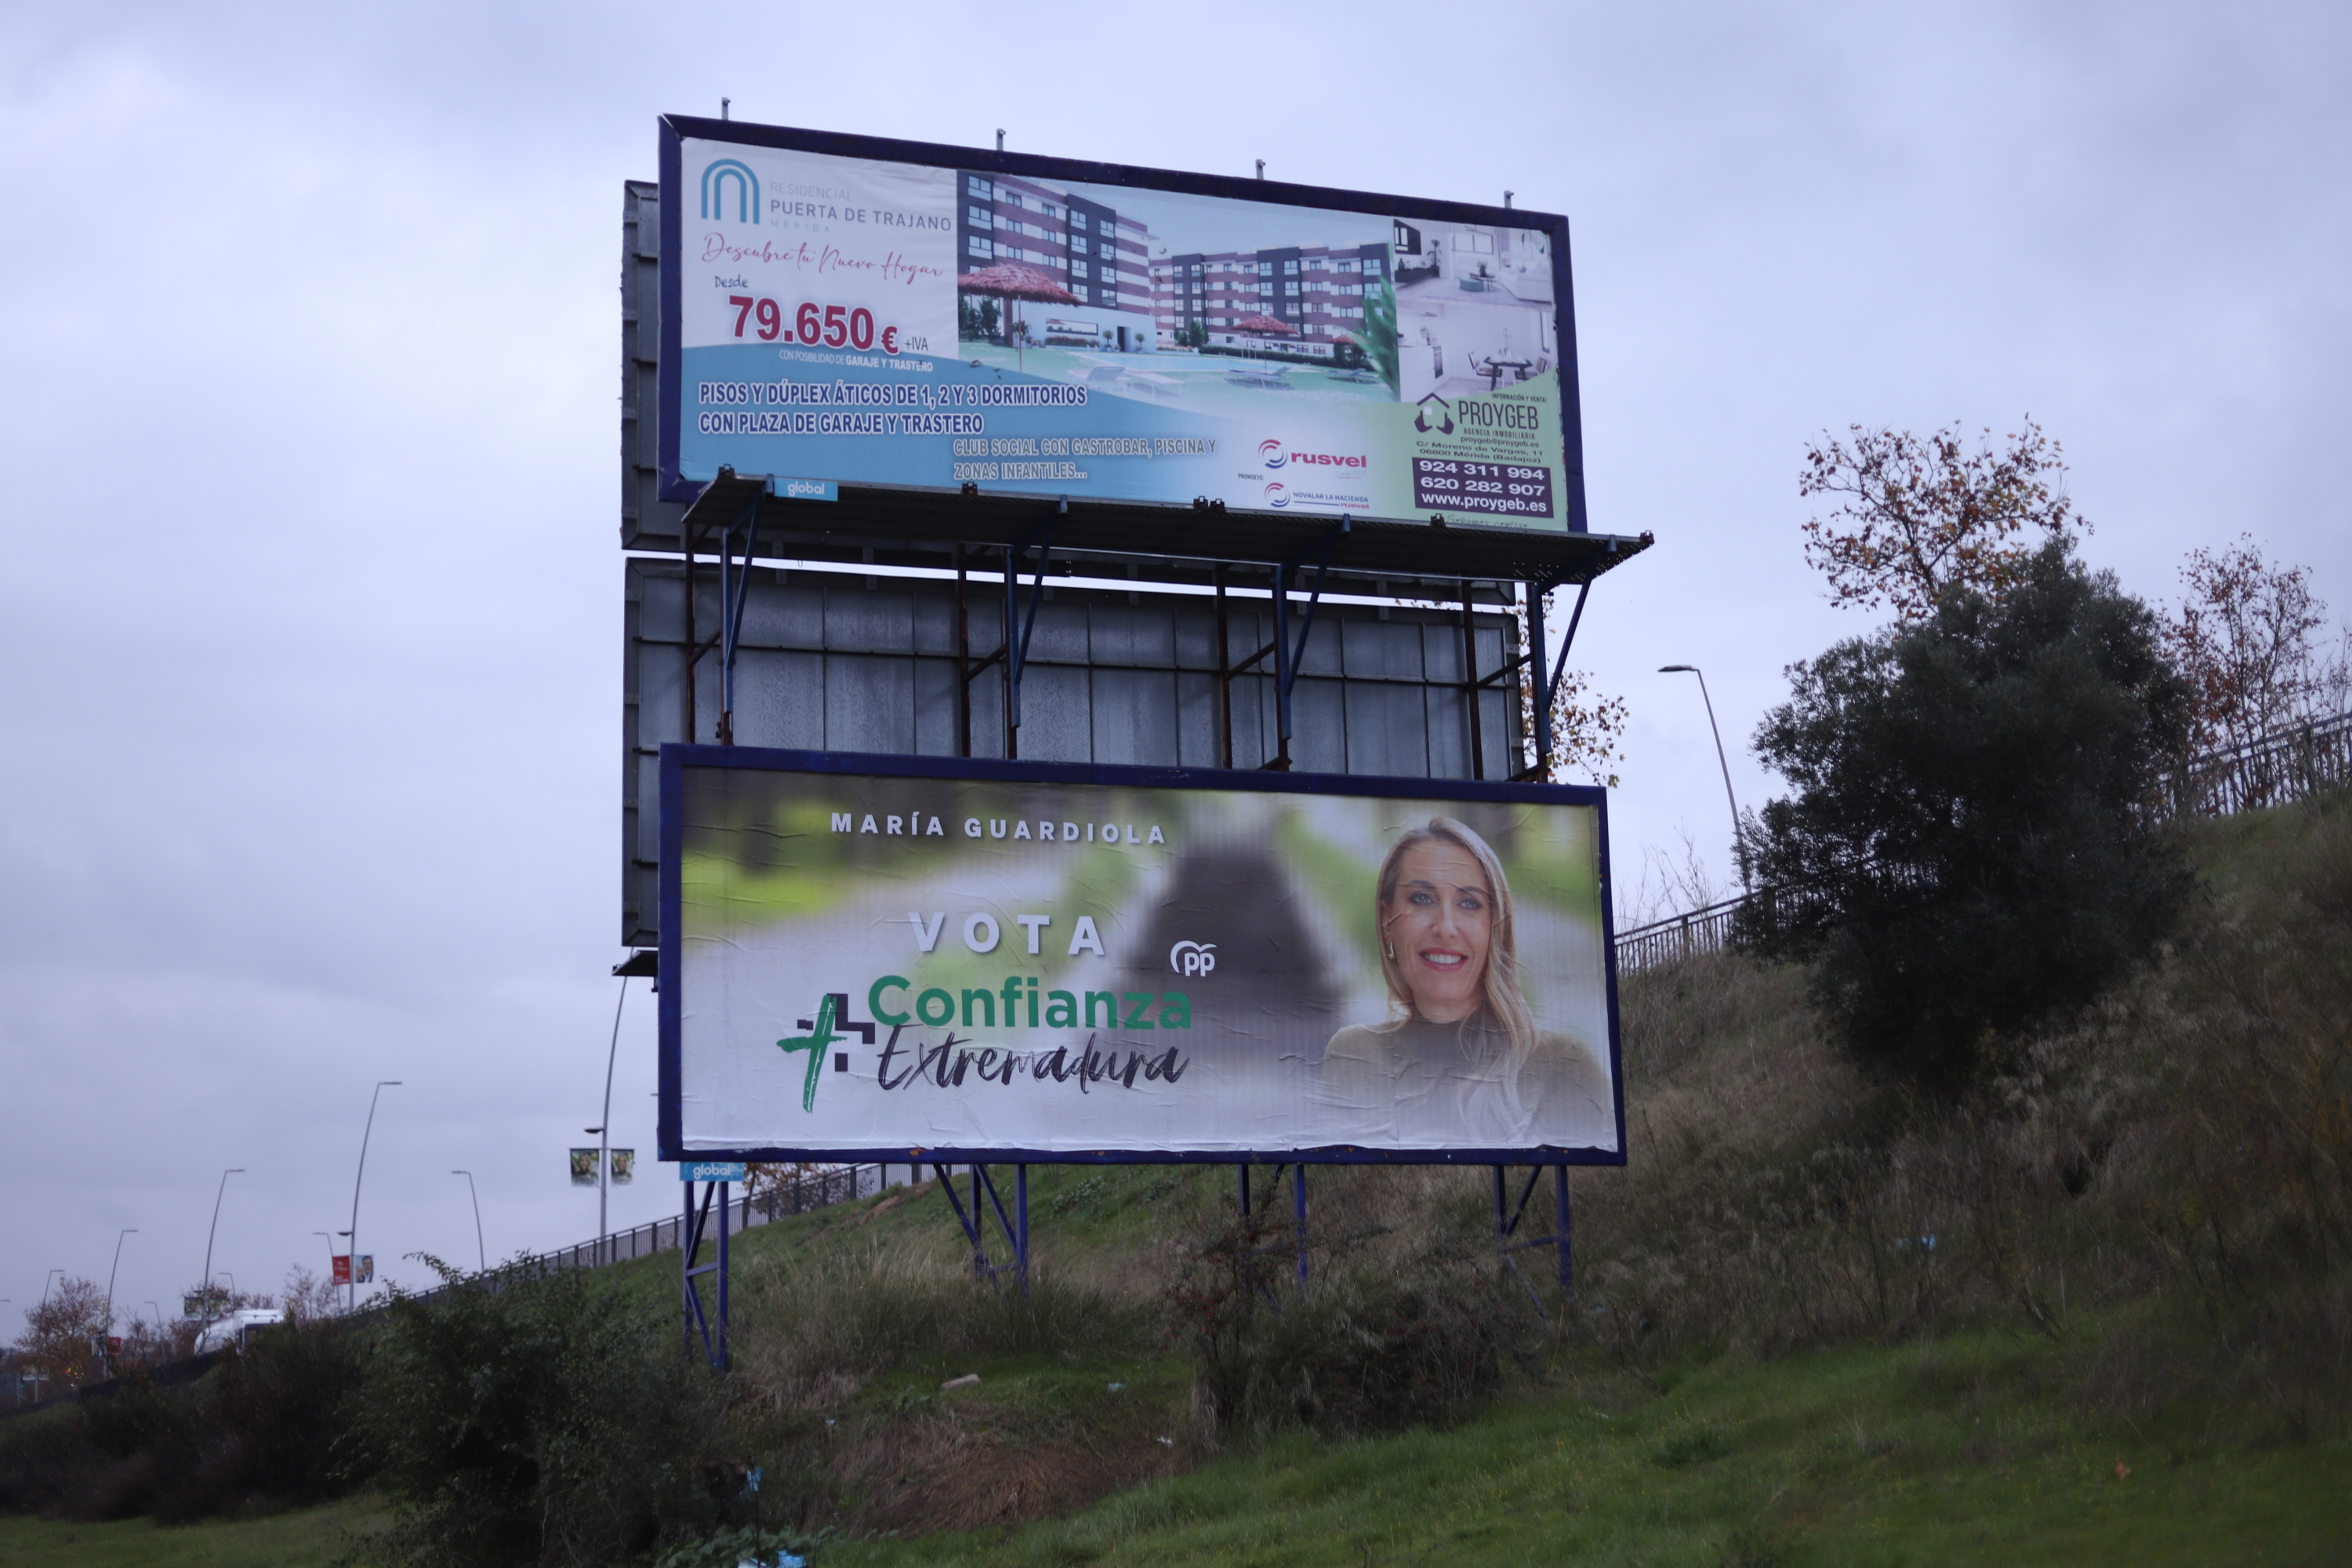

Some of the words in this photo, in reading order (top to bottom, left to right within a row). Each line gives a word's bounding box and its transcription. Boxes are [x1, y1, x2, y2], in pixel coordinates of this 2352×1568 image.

[771, 181, 853, 201] RESIDENCIAL
[771, 200, 837, 220] PUERTA
[844, 209, 866, 223] DE
[873, 211, 952, 231] TRAJANO
[771, 219, 830, 234] MÉRIDA
[702, 232, 792, 263] Descubre
[793, 242, 815, 270] tu
[819, 245, 875, 274] Nuevo
[881, 251, 944, 285] Hogar
[714, 274, 748, 289] Desde
[728, 294, 874, 350] 79.650
[905, 336, 929, 352] +IVA
[779, 350, 793, 360] CON
[794, 350, 835, 364] POSIBILIDAD
[836, 354, 844, 365] DE
[845, 354, 879, 368] GARAJE
[880, 358, 887, 368] Y
[888, 358, 933, 372] TRASTERO
[699, 382, 748, 405] PISOS
[750, 383, 764, 405] Y
[767, 379, 830, 405] DÚPLEX
[833, 379, 891, 406] ÁTICOS
[895, 384, 916, 405] DE
[920, 385, 936, 410] 1,
[938, 385, 949, 406] 2
[952, 385, 965, 406] Y
[967, 385, 978, 406] 3
[981, 384, 1087, 406] DORMITORIOS
[1491, 393, 1525, 401] INFORMACIÓN
[699, 412, 735, 434] CON
[738, 412, 789, 434] PLAZA
[793, 412, 816, 434] DE
[818, 412, 884, 434] GARAJE
[886, 412, 898, 434] Y
[901, 412, 985, 435] TRASTERO
[1458, 400, 1539, 430] PROYGEB
[1461, 436, 1539, 448] proygeb@proygeb.es
[1464, 428, 1490, 437] AGENCIA
[1492, 430, 1535, 440] INMOBILIARIA
[953, 438, 989, 456] CLUB
[991, 438, 1039, 456] SOCIAL
[1040, 438, 1069, 456] CON
[1071, 438, 1152, 459] GASTROBAR,
[1155, 437, 1205, 456] PISCINA
[1208, 438, 1216, 455] Y
[1432, 441, 1472, 451] Moreno
[1490, 447, 1529, 456] Vargas,
[1454, 451, 1490, 459] Mérida
[1494, 454, 1541, 463] (Badajoz)
[1291, 452, 1367, 468] rusvel
[954, 463, 999, 480] ZONAS
[1001, 462, 1087, 480] INFANTILES...
[1238, 473, 1265, 481] PROMUEVE:
[1419, 460, 1457, 474] 924
[1464, 463, 1499, 477] 311
[1507, 467, 1544, 481] 994
[787, 481, 825, 496] global
[1421, 477, 1459, 490] 620
[1465, 480, 1503, 494] 282
[1508, 483, 1544, 496] 907
[1294, 492, 1324, 500] NOVALAR
[1335, 495, 1369, 503] HACIENDA
[1421, 493, 1547, 512] www.proygeb.es
[830, 811, 944, 837] MARÍA
[964, 818, 1166, 844] GUARDIOLA
[907, 911, 1105, 956] VOTA
[868, 975, 1192, 1029] Confianza
[877, 1023, 1190, 1094] Extremadura
[693, 1164, 731, 1179] global
